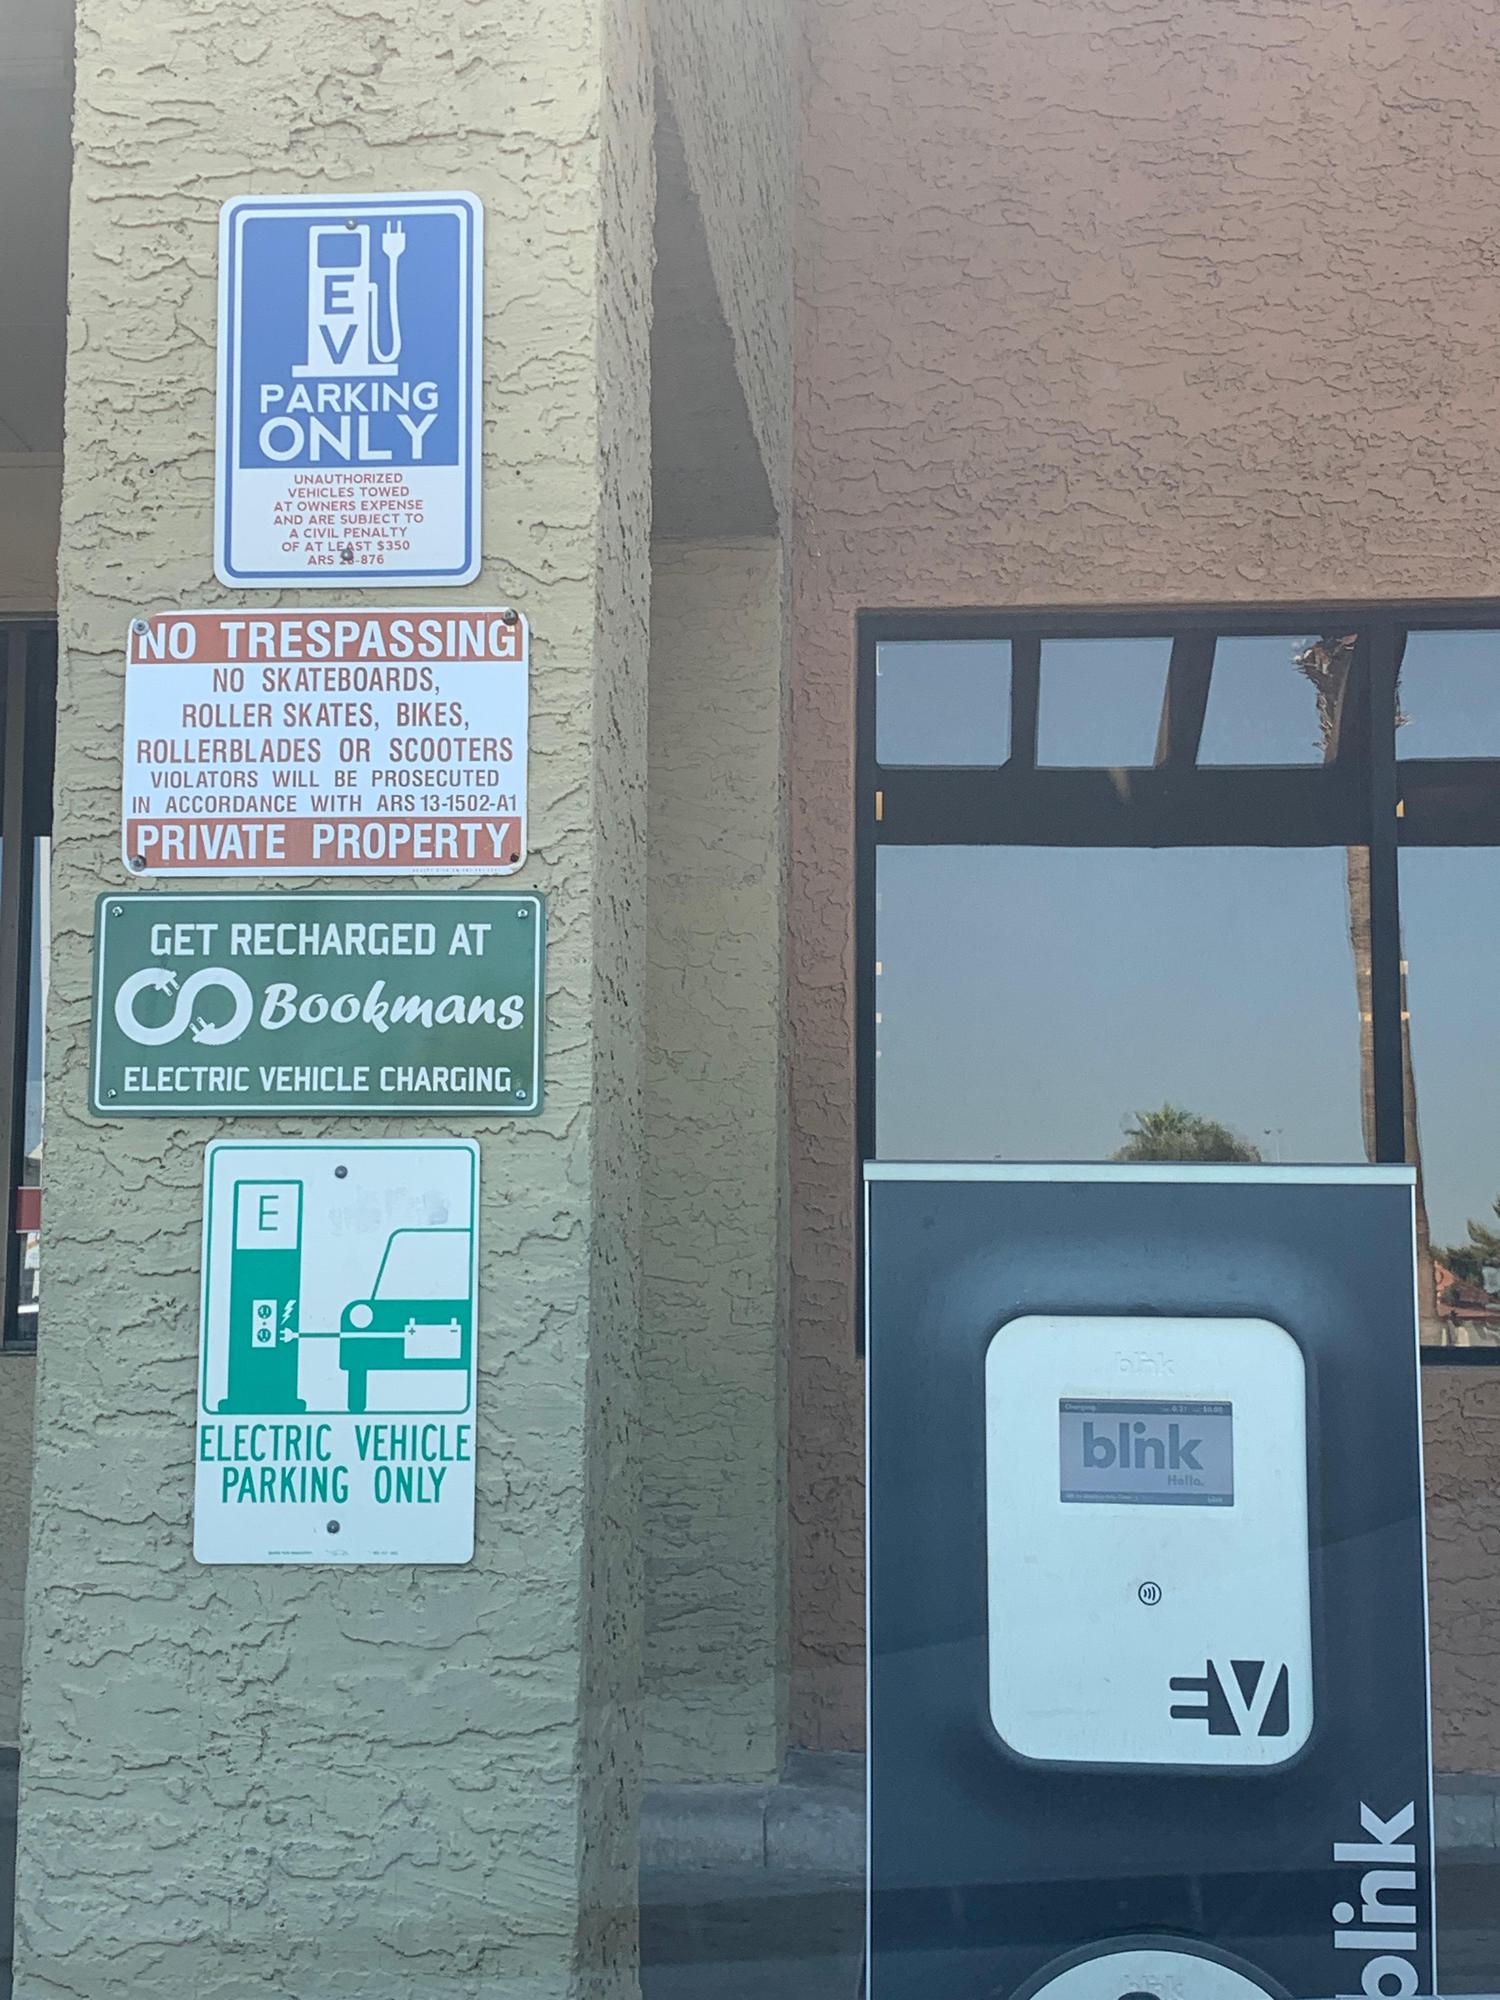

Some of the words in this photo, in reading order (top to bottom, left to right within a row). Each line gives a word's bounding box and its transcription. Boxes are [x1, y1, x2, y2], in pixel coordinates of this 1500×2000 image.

[260, 381, 438, 414] PARKING
[258, 413, 438, 462] ONLY
[288, 487, 355, 498] VEHICLES
[359, 486, 410, 497] TOWED
[294, 473, 403, 484] UNAUTHORIZED
[273, 501, 293, 512] AT
[297, 500, 356, 511] OWNERS
[361, 499, 424, 510] EXPENSE
[273, 514, 303, 525] AND
[308, 514, 335, 525] ARE
[340, 513, 400, 524] SUBJECT
[404, 513, 424, 523] TO
[281, 542, 300, 552] OF
[304, 541, 323, 552] AT
[328, 541, 373, 552] LEAST
[377, 540, 410, 551] $350
[289, 528, 299, 538] A
[303, 527, 339, 538] CIVIL
[343, 526, 408, 538] PENALTY
[307, 555, 335, 566] ARS
[137, 621, 197, 660] NO
[220, 618, 516, 659] TRESPASSING
[213, 667, 244, 693] NO
[262, 666, 440, 695] SKATEBOARDS,
[182, 703, 273, 729] ROLLER
[283, 702, 380, 731] SKATES,
[396, 702, 470, 731] BIKES,
[136, 738, 321, 764] ROLLERBLADES
[339, 738, 371, 763] OR
[389, 737, 513, 762] SCOOTERS
[150, 770, 258, 789] VIOLATORS
[272, 770, 320, 788] WILL
[334, 770, 357, 788] BE
[371, 769, 500, 787] PROSECUTED
[132, 796, 151, 814] IN
[165, 795, 297, 814] ACCORDANCE
[311, 795, 362, 812] WITH
[376, 795, 415, 812] ARS
[422, 794, 518, 812] 13-1502-A1
[136, 824, 286, 861] PRIVATE
[312, 822, 511, 860] PROPERTY
[150, 923, 218, 956] GET
[230, 923, 436, 956] RECHARGED
[448, 923, 492, 956] AT
[259, 979, 525, 1033] Bookmans
[124, 1066, 250, 1092] ELECTRIC
[259, 1066, 370, 1092] VEHICLE
[380, 1066, 511, 1093] CHARGING
[258, 1194, 279, 1232] E
[200, 1424, 333, 1462] ELECTRIC
[354, 1424, 471, 1462] VEHICLE
[1082, 1420, 1204, 1470] blink
[221, 1466, 349, 1504] PARKING
[373, 1466, 447, 1504] ONLY
[1332, 1800, 1419, 1999] blink
